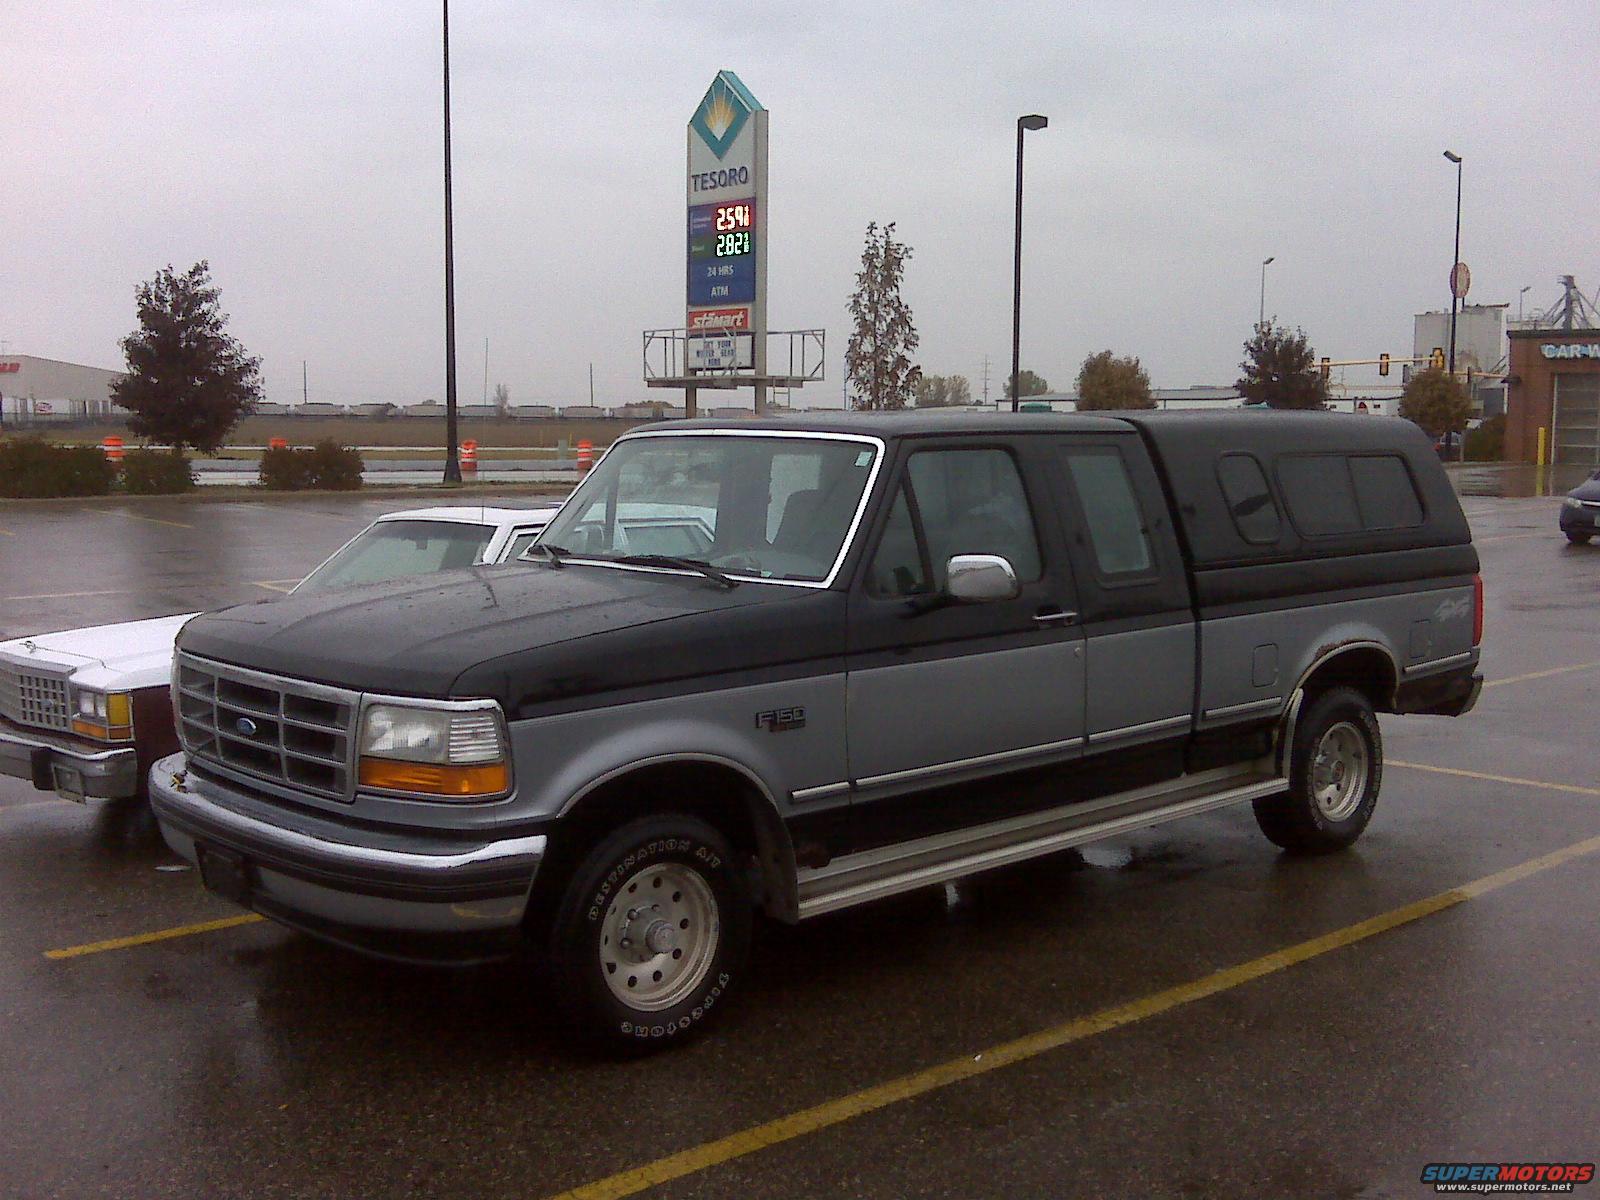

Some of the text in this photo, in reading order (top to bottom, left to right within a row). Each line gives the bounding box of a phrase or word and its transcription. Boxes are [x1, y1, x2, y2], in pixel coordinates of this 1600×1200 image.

[691, 166, 748, 192] TESORO
[707, 264, 734, 277] 24 HRS
[711, 285, 729, 297] ATM
[1541, 344, 1581, 358] CAR
